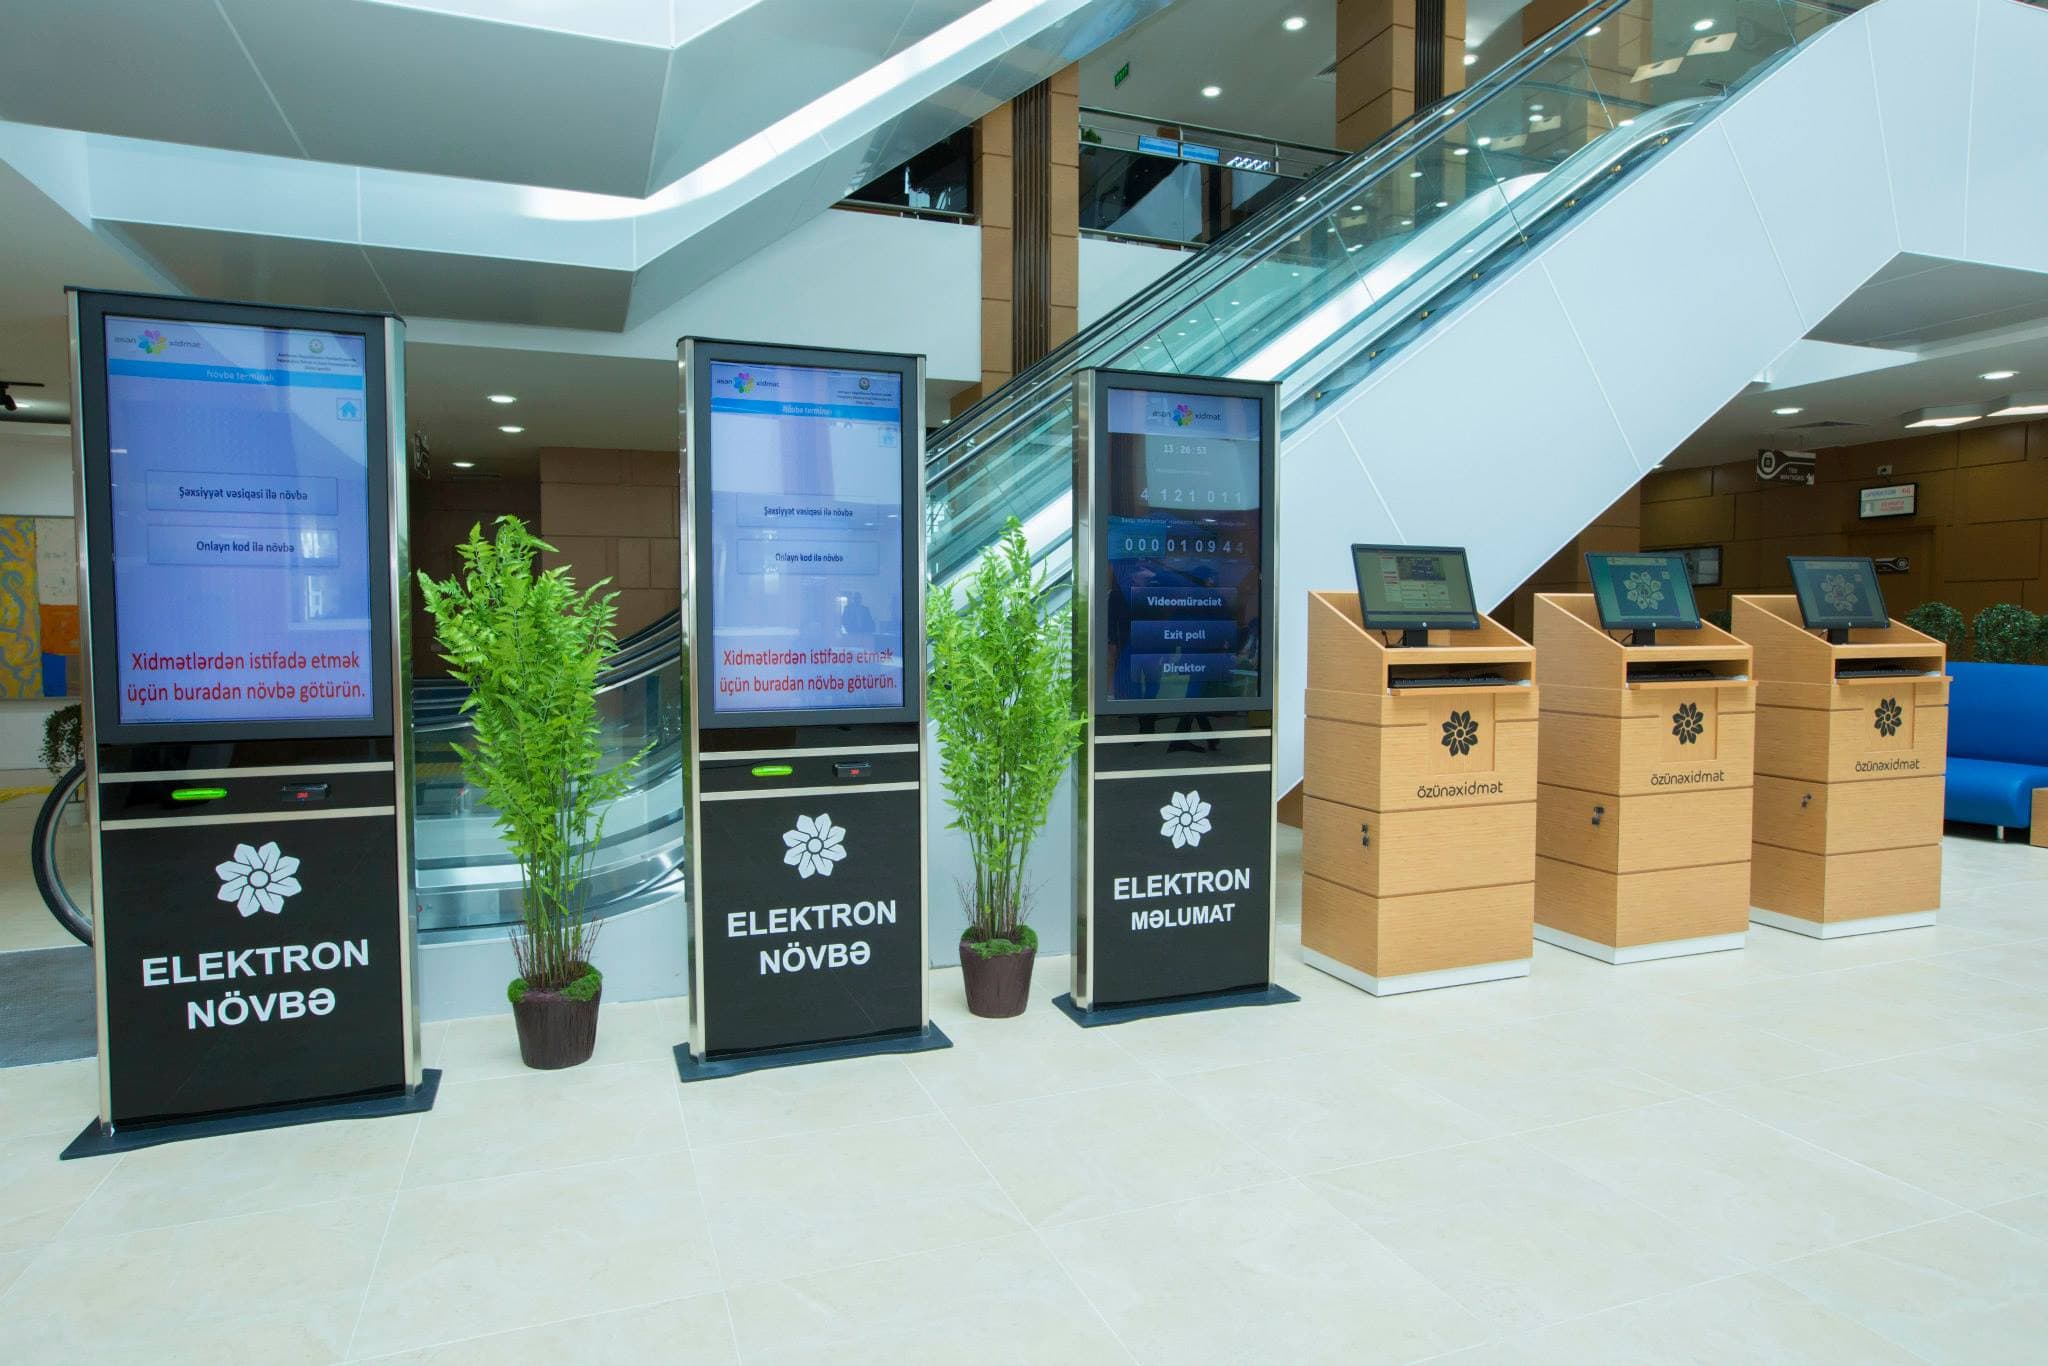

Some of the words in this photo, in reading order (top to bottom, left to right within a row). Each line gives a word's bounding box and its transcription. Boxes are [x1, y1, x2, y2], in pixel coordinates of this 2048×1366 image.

[179, 486, 225, 500] Şəxsiyyət
[226, 488, 264, 501] vəsiqəsi
[266, 488, 278, 500] ilə
[280, 489, 308, 501] növbə
[196, 541, 231, 554] Onlayn
[232, 541, 251, 553] kod
[252, 542, 264, 553] ilə
[266, 542, 295, 553] növbə
[1164, 629, 1183, 640] Exit
[1185, 629, 1206, 642] poll
[132, 652, 245, 671] Xidmətlərdən
[249, 651, 307, 670] istifadə
[311, 650, 360, 669] etmək
[723, 650, 807, 666] Xidmətlərdən
[810, 649, 854, 665] istifadə
[856, 648, 893, 664] etmək
[1163, 662, 1207, 673] Direktor
[127, 683, 169, 706] üçün
[173, 682, 242, 701] buradan
[247, 682, 296, 700] növbə
[300, 680, 366, 703] götürün.
[720, 678, 750, 696] üçün
[754, 675, 805, 692] buradan
[807, 676, 845, 691] növbə
[847, 674, 897, 693] götürün.
[1113, 867, 1251, 900] ELEKTRON
[727, 899, 897, 938] ELEKTRON
[1131, 903, 1236, 931] MƏLUMAT
[142, 938, 369, 987] ELEKTRON
[759, 940, 871, 975] NÖVBƏ
[187, 987, 336, 1030] NÖVBƏ
